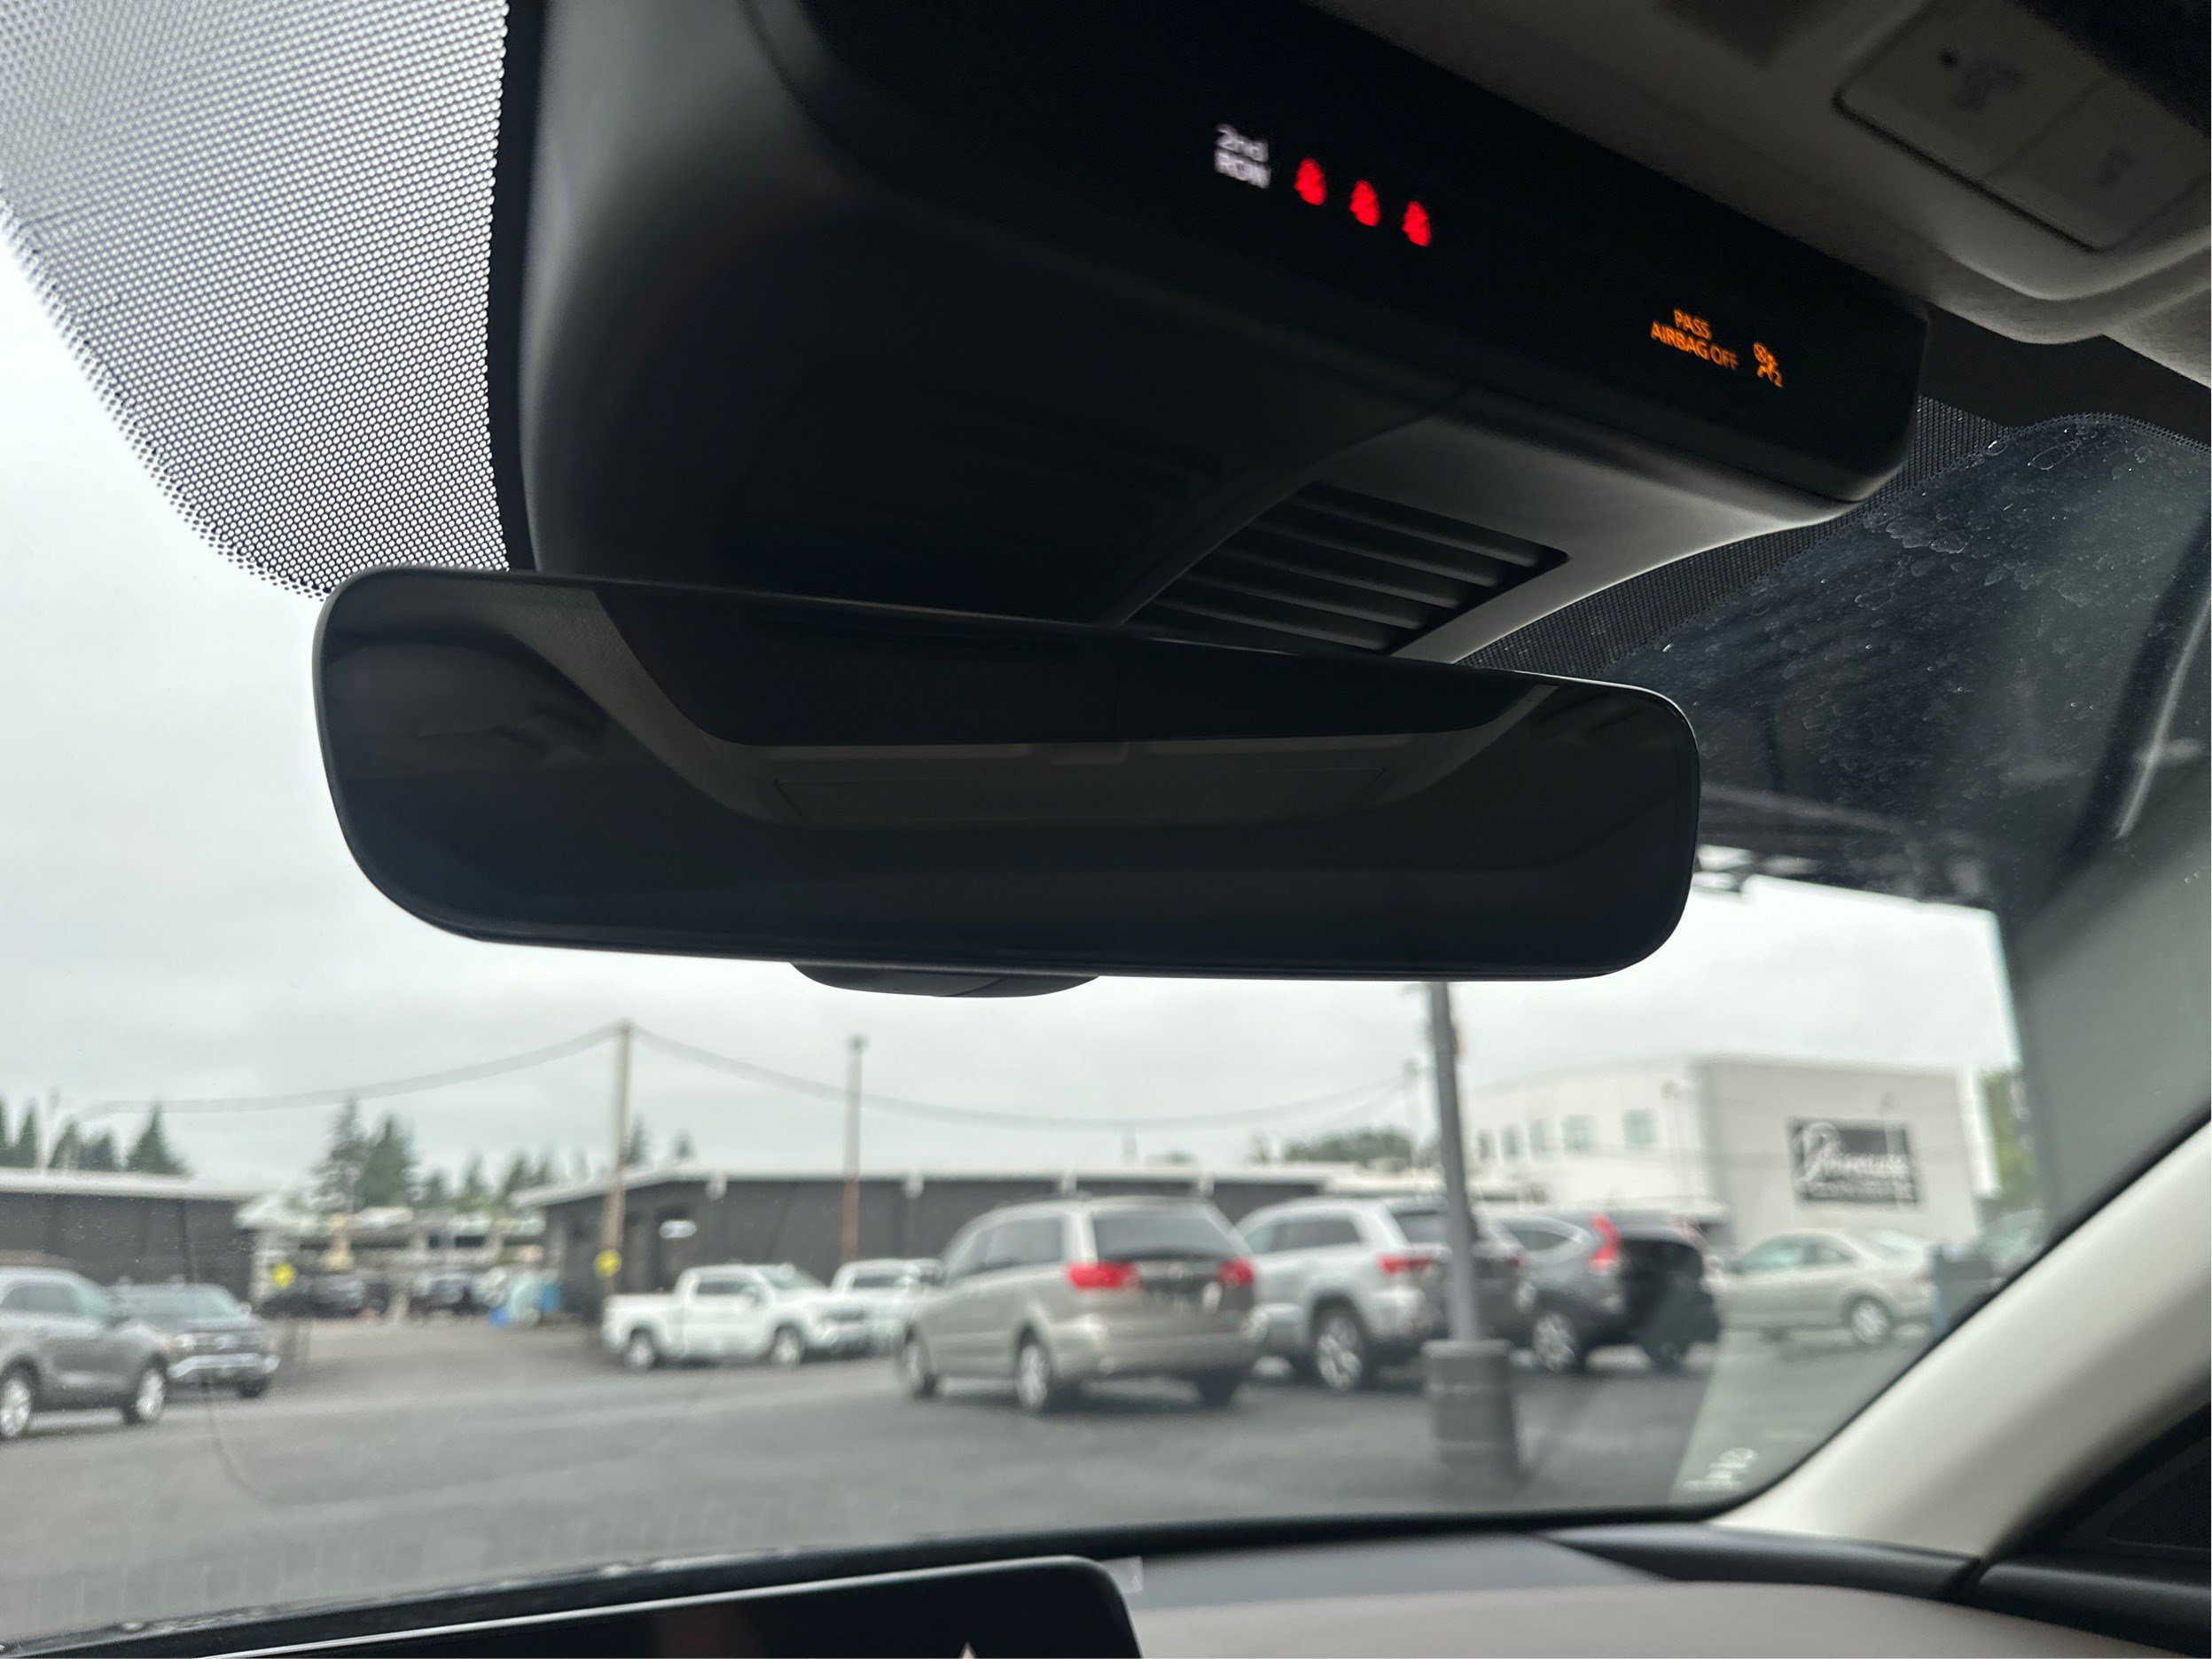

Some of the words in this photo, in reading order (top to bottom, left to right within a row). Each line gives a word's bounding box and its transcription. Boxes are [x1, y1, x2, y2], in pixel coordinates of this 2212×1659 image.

[1215, 125, 1269, 162] 2nd
[1215, 148, 1270, 188] ROW
[1674, 309, 1712, 340] PASS
[1651, 321, 1709, 360] AIRBAG
[1710, 344, 1739, 369] OFF
